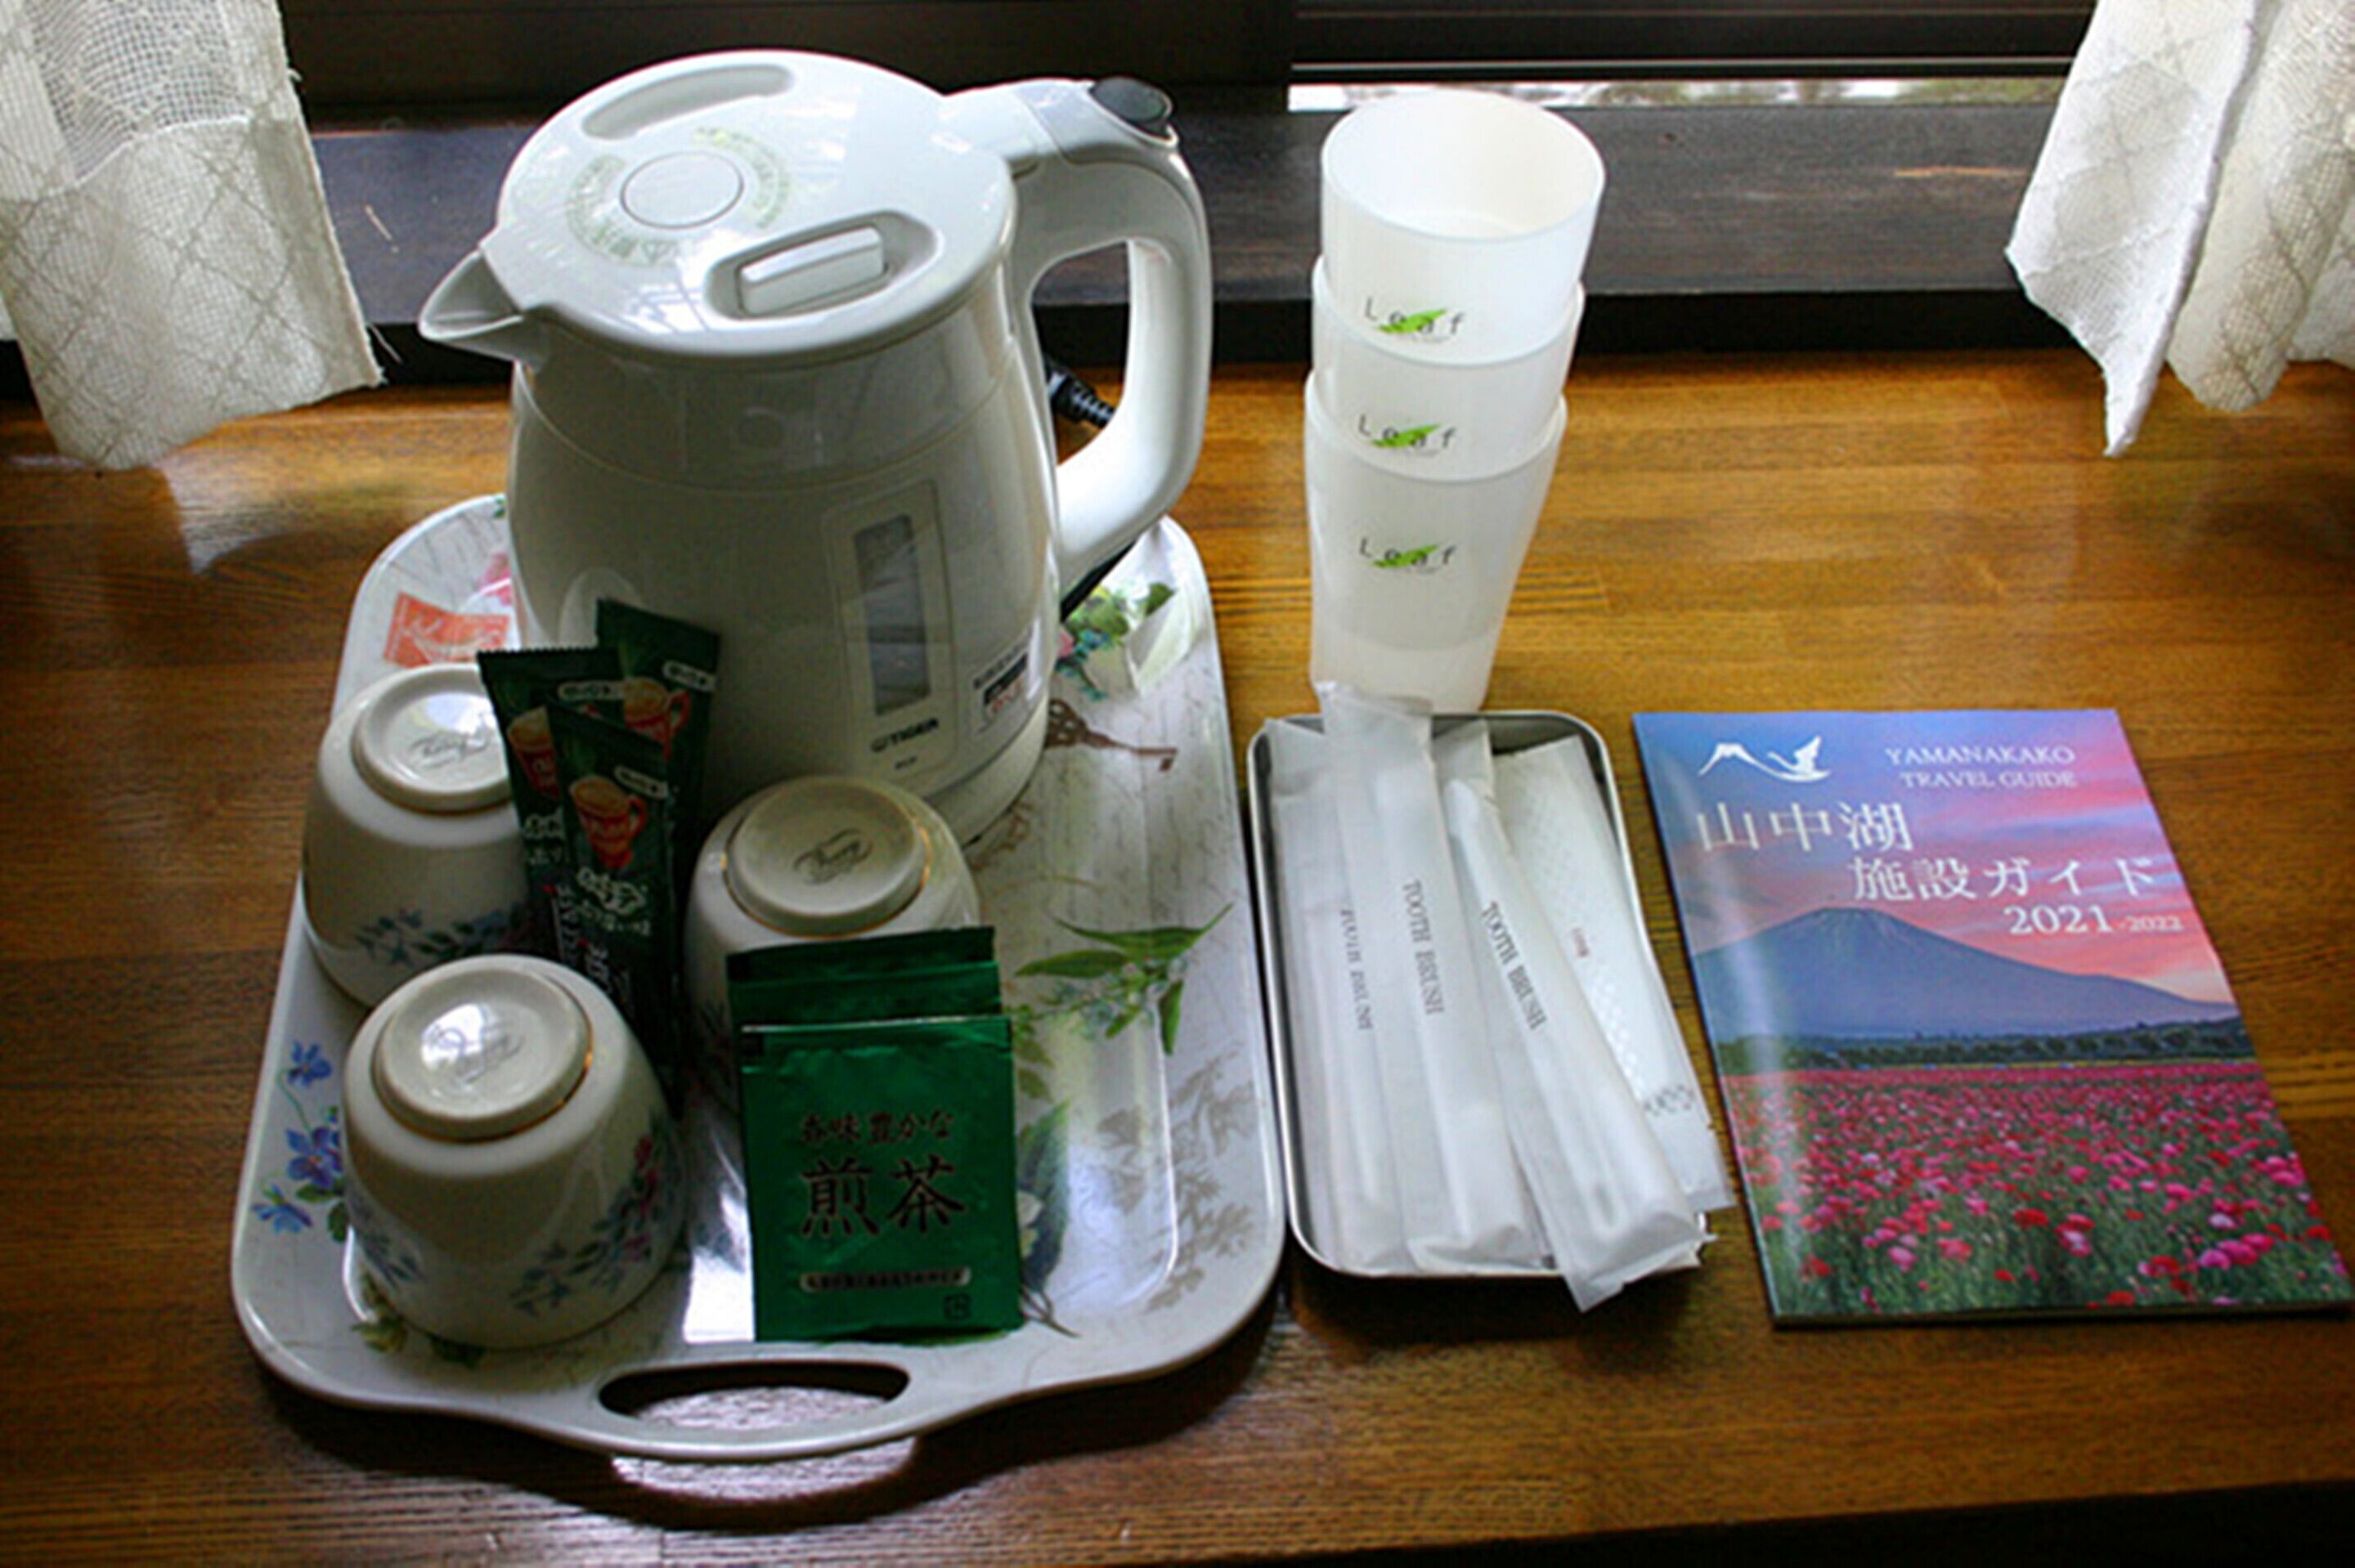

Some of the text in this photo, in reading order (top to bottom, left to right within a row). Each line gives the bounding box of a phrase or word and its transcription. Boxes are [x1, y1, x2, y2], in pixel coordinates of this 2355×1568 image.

[1883, 746, 2076, 768] YAMANAKAKO
[1901, 771, 2077, 790] TRAVEL GUIDE
[1696, 801, 1914, 853] 山中湖
[1847, 857, 2157, 901] 施設ガイド
[1402, 879, 1431, 943] TOOTH
[801, 1154, 967, 1235] 煎茶
